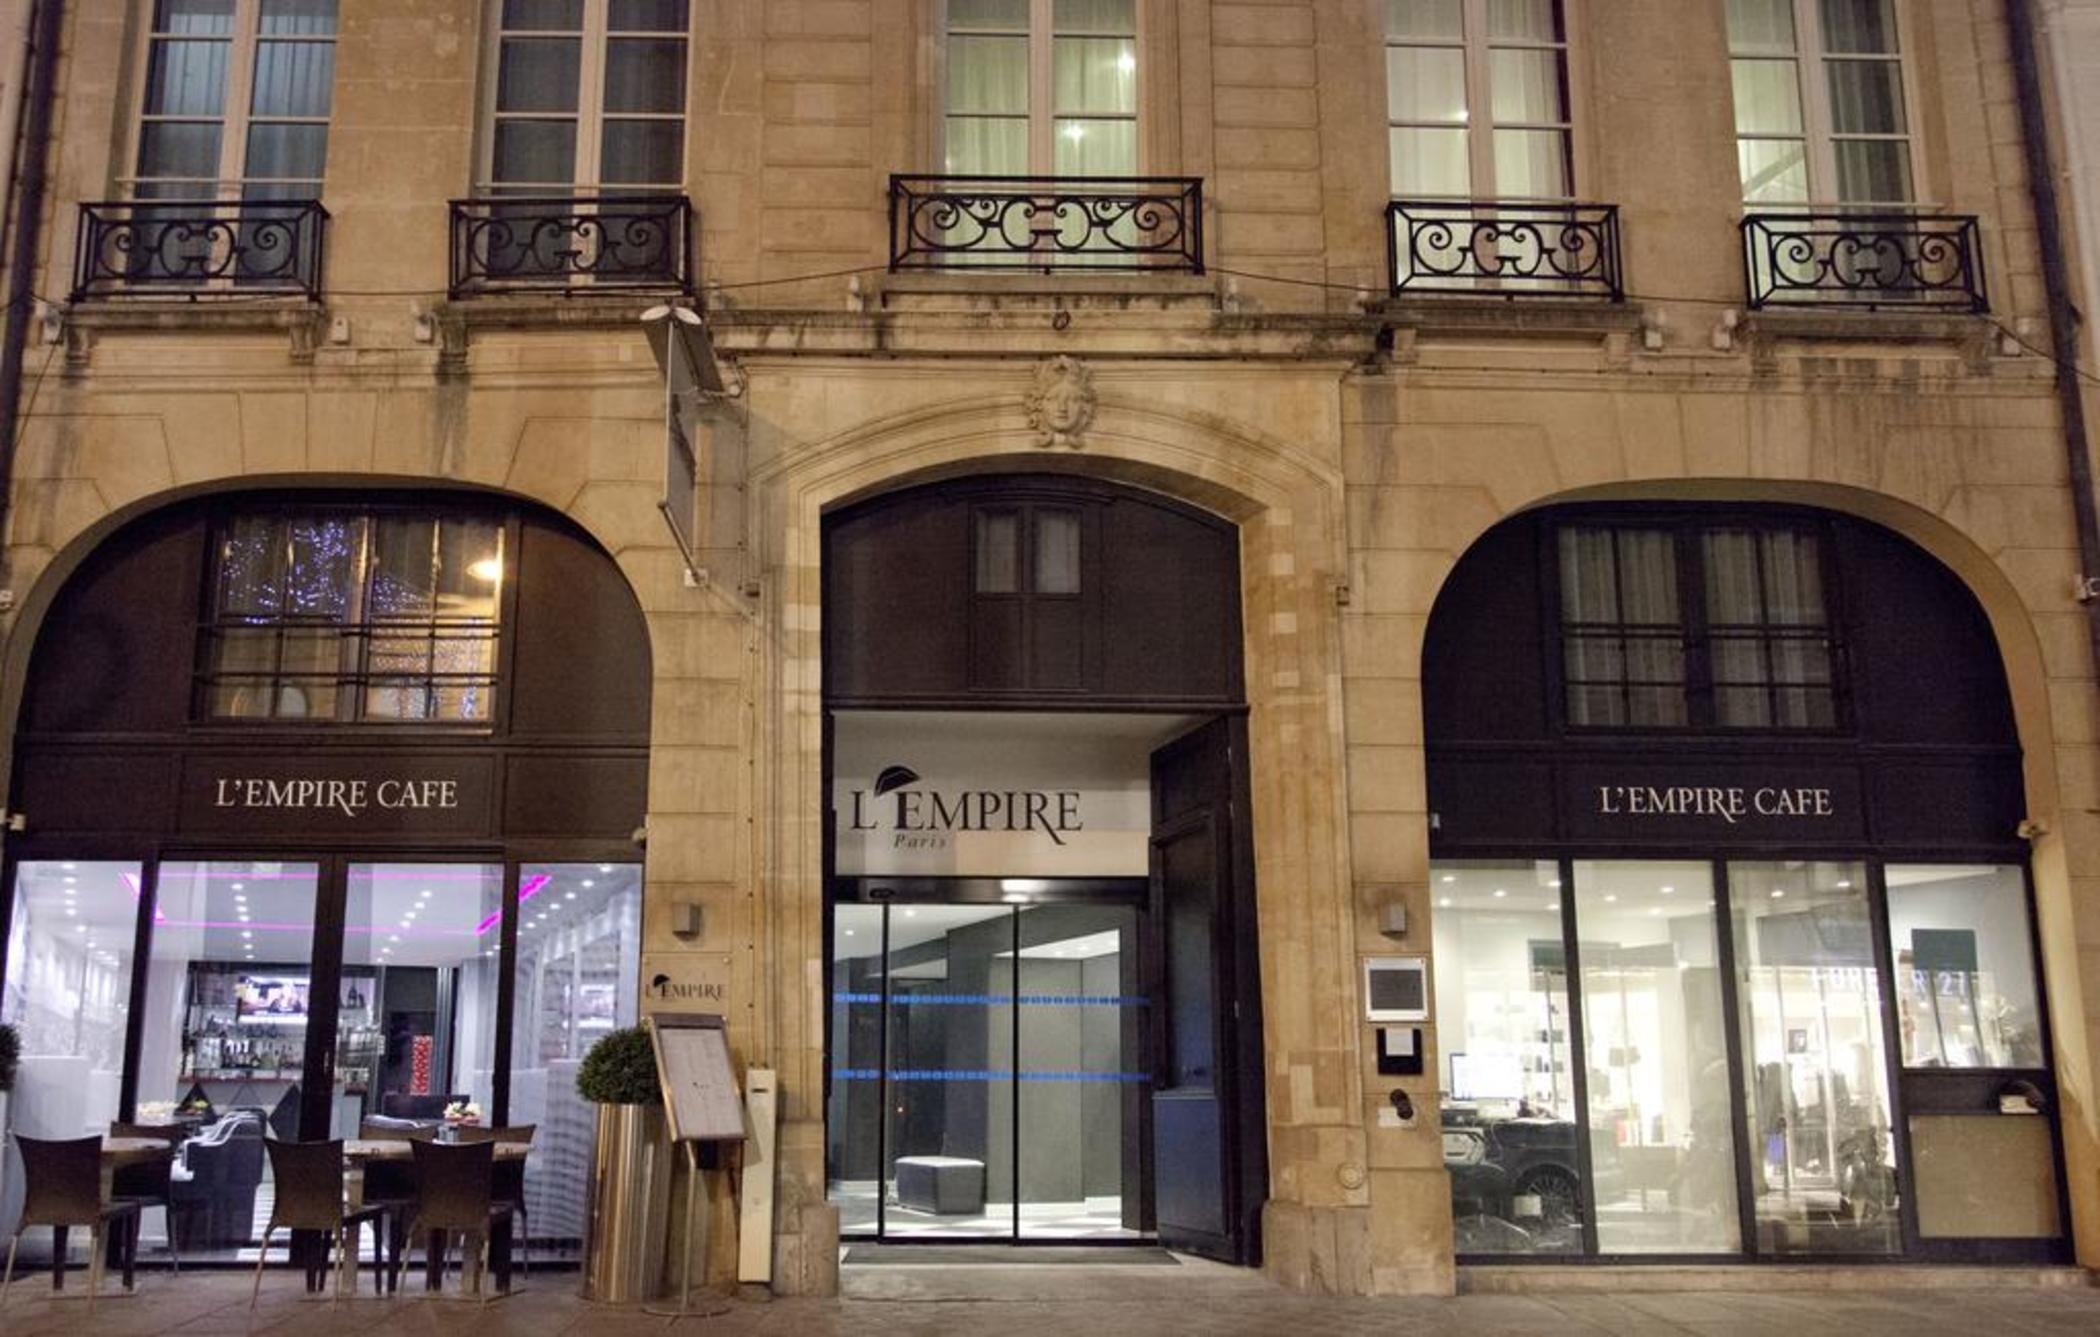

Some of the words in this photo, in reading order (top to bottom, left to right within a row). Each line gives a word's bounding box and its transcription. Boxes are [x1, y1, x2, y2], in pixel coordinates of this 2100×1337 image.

[215, 779, 369, 817] L'EMPIRE
[376, 780, 459, 808] CAFE
[1599, 786, 1747, 823] L'EMPIRE
[1754, 788, 1834, 815] CAFE
[892, 833, 948, 849] Paris
